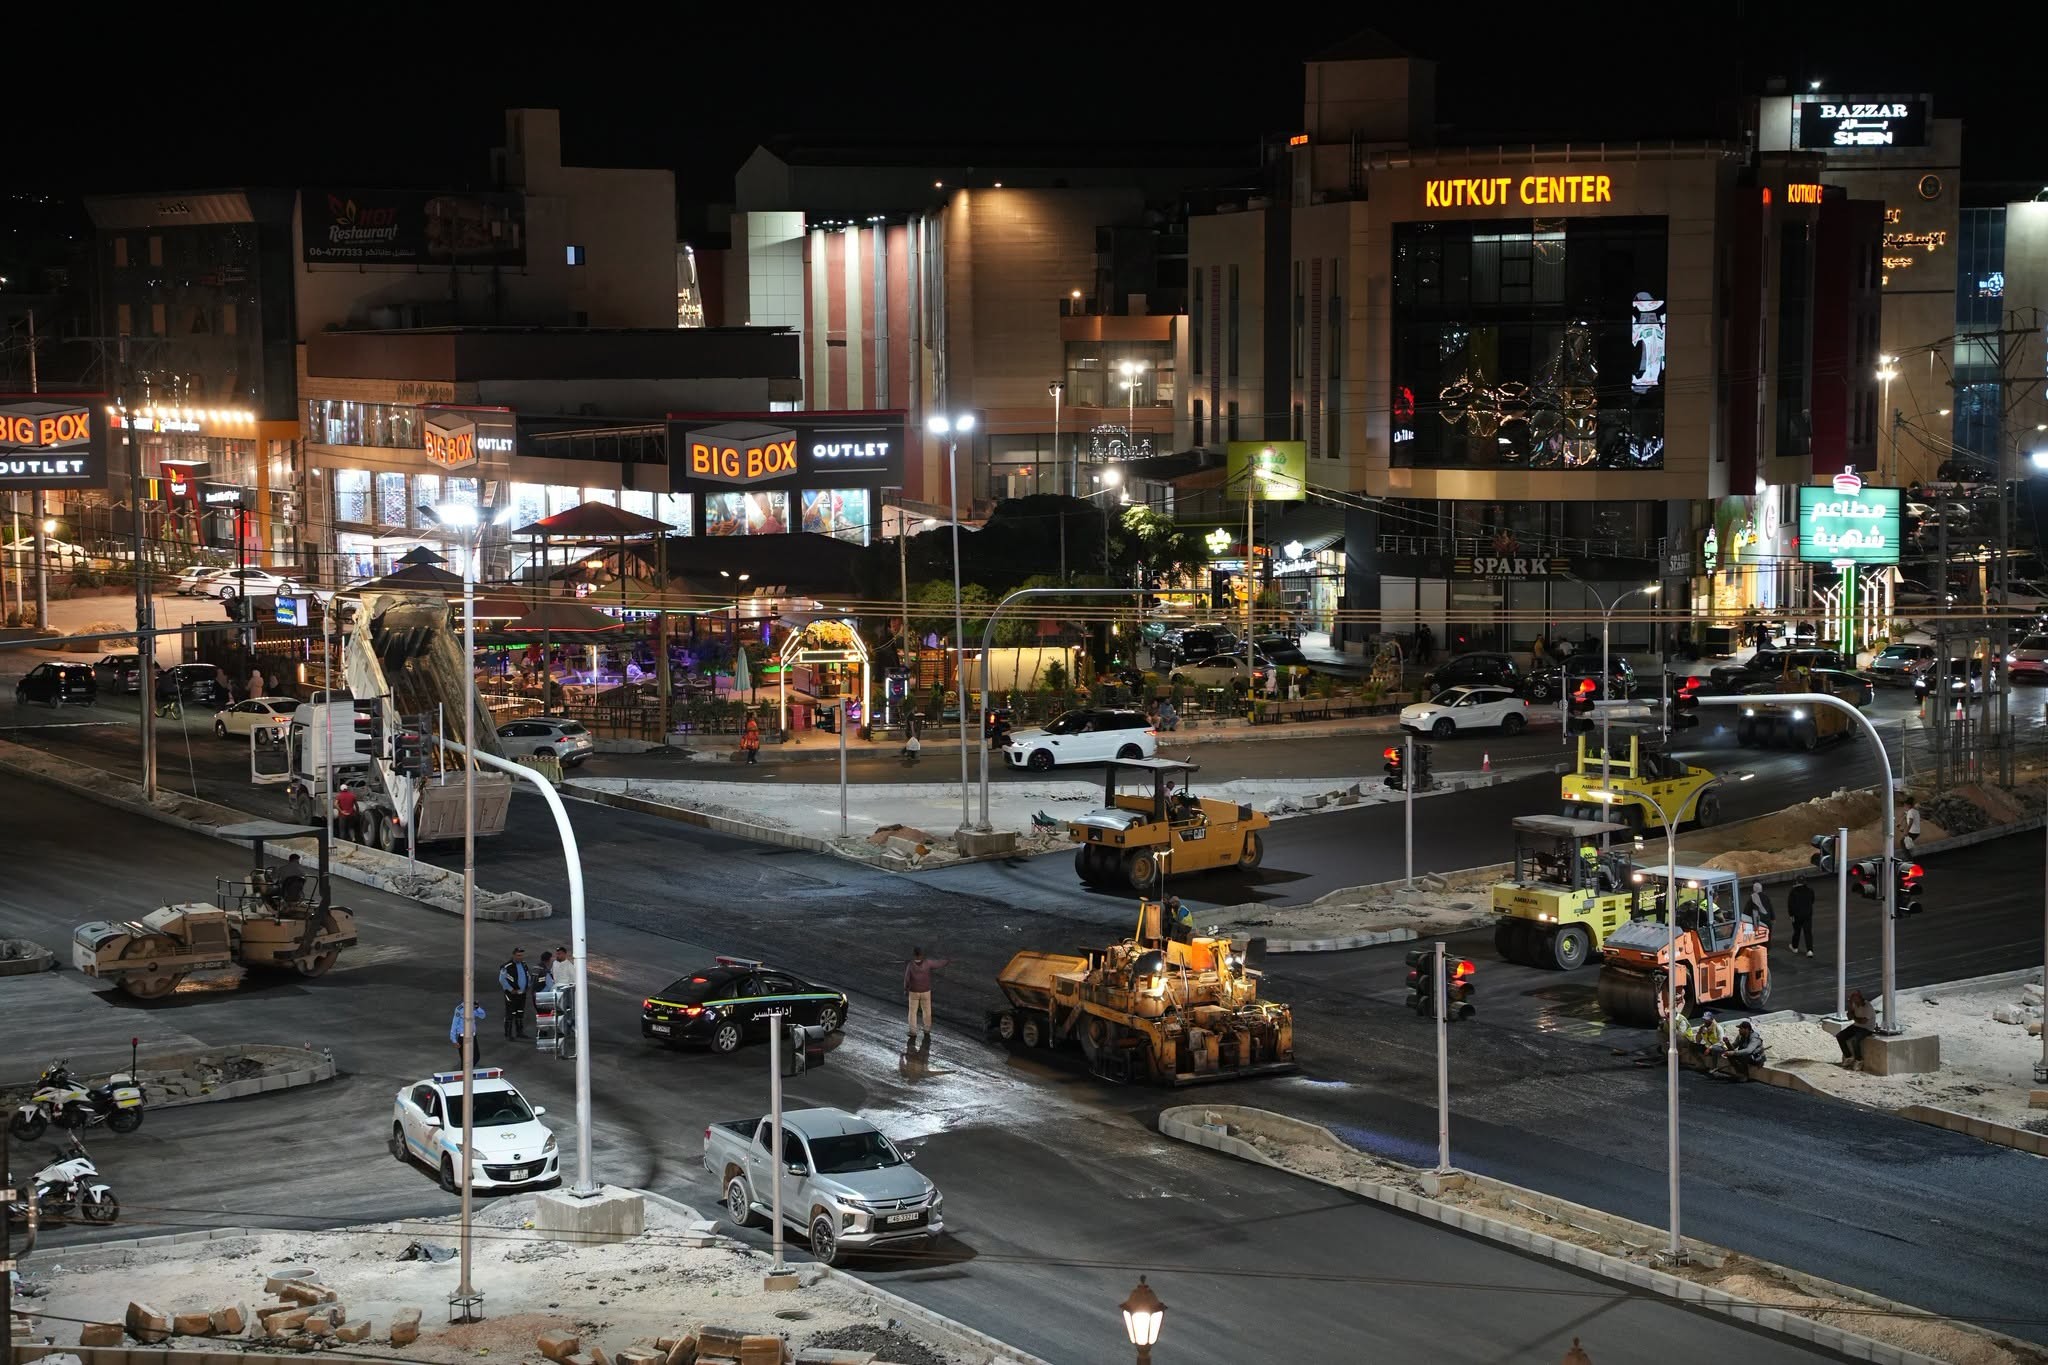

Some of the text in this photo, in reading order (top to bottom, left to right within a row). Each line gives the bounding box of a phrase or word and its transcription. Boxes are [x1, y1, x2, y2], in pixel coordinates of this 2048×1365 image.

[1820, 104, 1908, 118] BAZZAR
[1834, 132, 1893, 145] SHEIN
[1426, 175, 1611, 207] KUTKUT CENTER
[1788, 183, 1817, 203] KUTKUT
[329, 224, 400, 242] Restaurant
[309, 247, 363, 256] 06-4777333
[40, 413, 89, 445] BOX
[424, 430, 513, 465] BIG BOX OUTLET
[692, 440, 889, 478] BIG BOX OUTLET
[1810, 500, 1887, 523] مطاعم
[1813, 524, 1886, 553] شهية
[1473, 557, 1548, 575] SPARK
[1193, 828, 1206, 840] CAT
[1513, 896, 1538, 905] AMMANN
